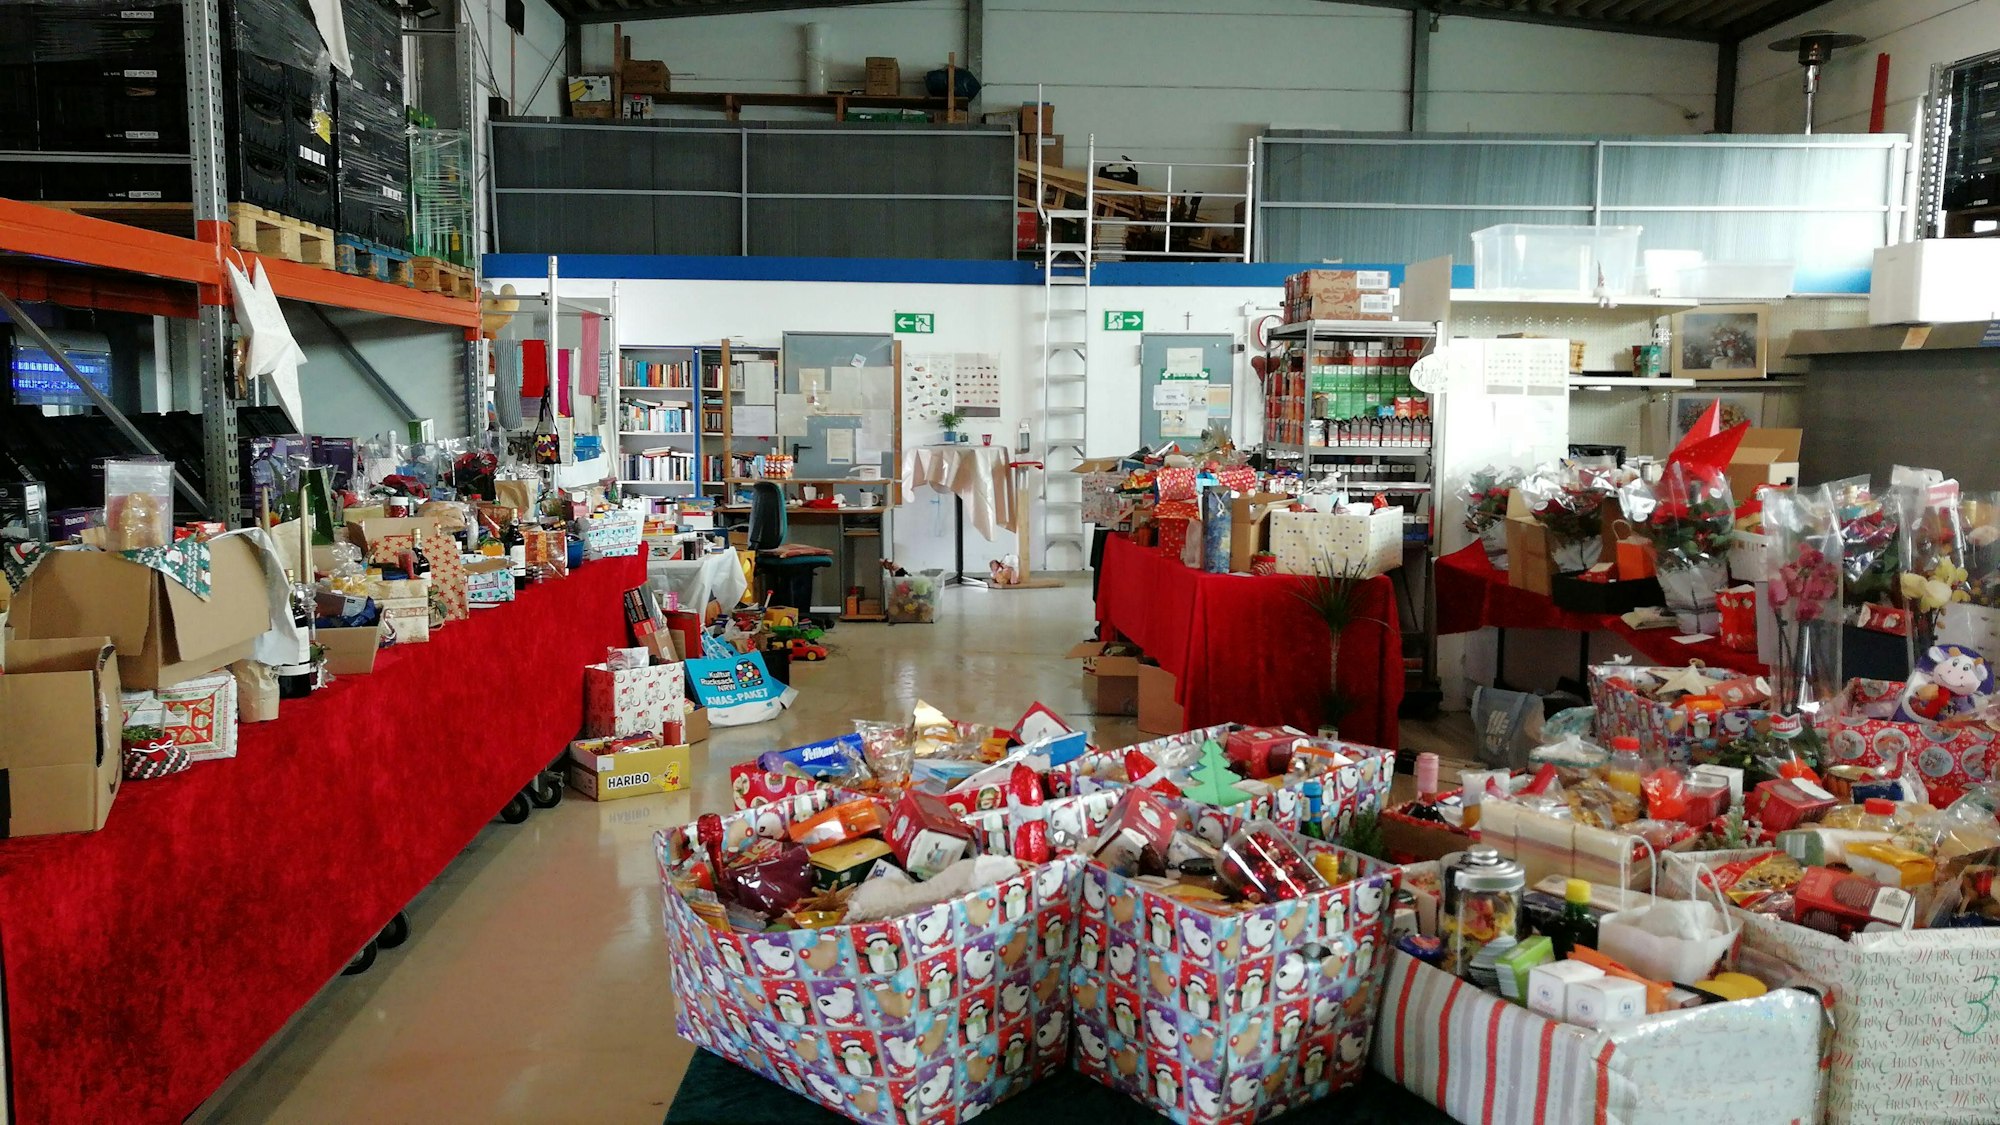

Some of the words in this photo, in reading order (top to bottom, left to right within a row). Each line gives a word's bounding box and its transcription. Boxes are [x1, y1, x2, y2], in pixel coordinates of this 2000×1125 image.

[700, 677, 734, 685] Rucksack
[709, 671, 730, 679] Kultur
[705, 688, 768, 705] XMAS-PAKET
[607, 772, 650, 789] HARIBO
